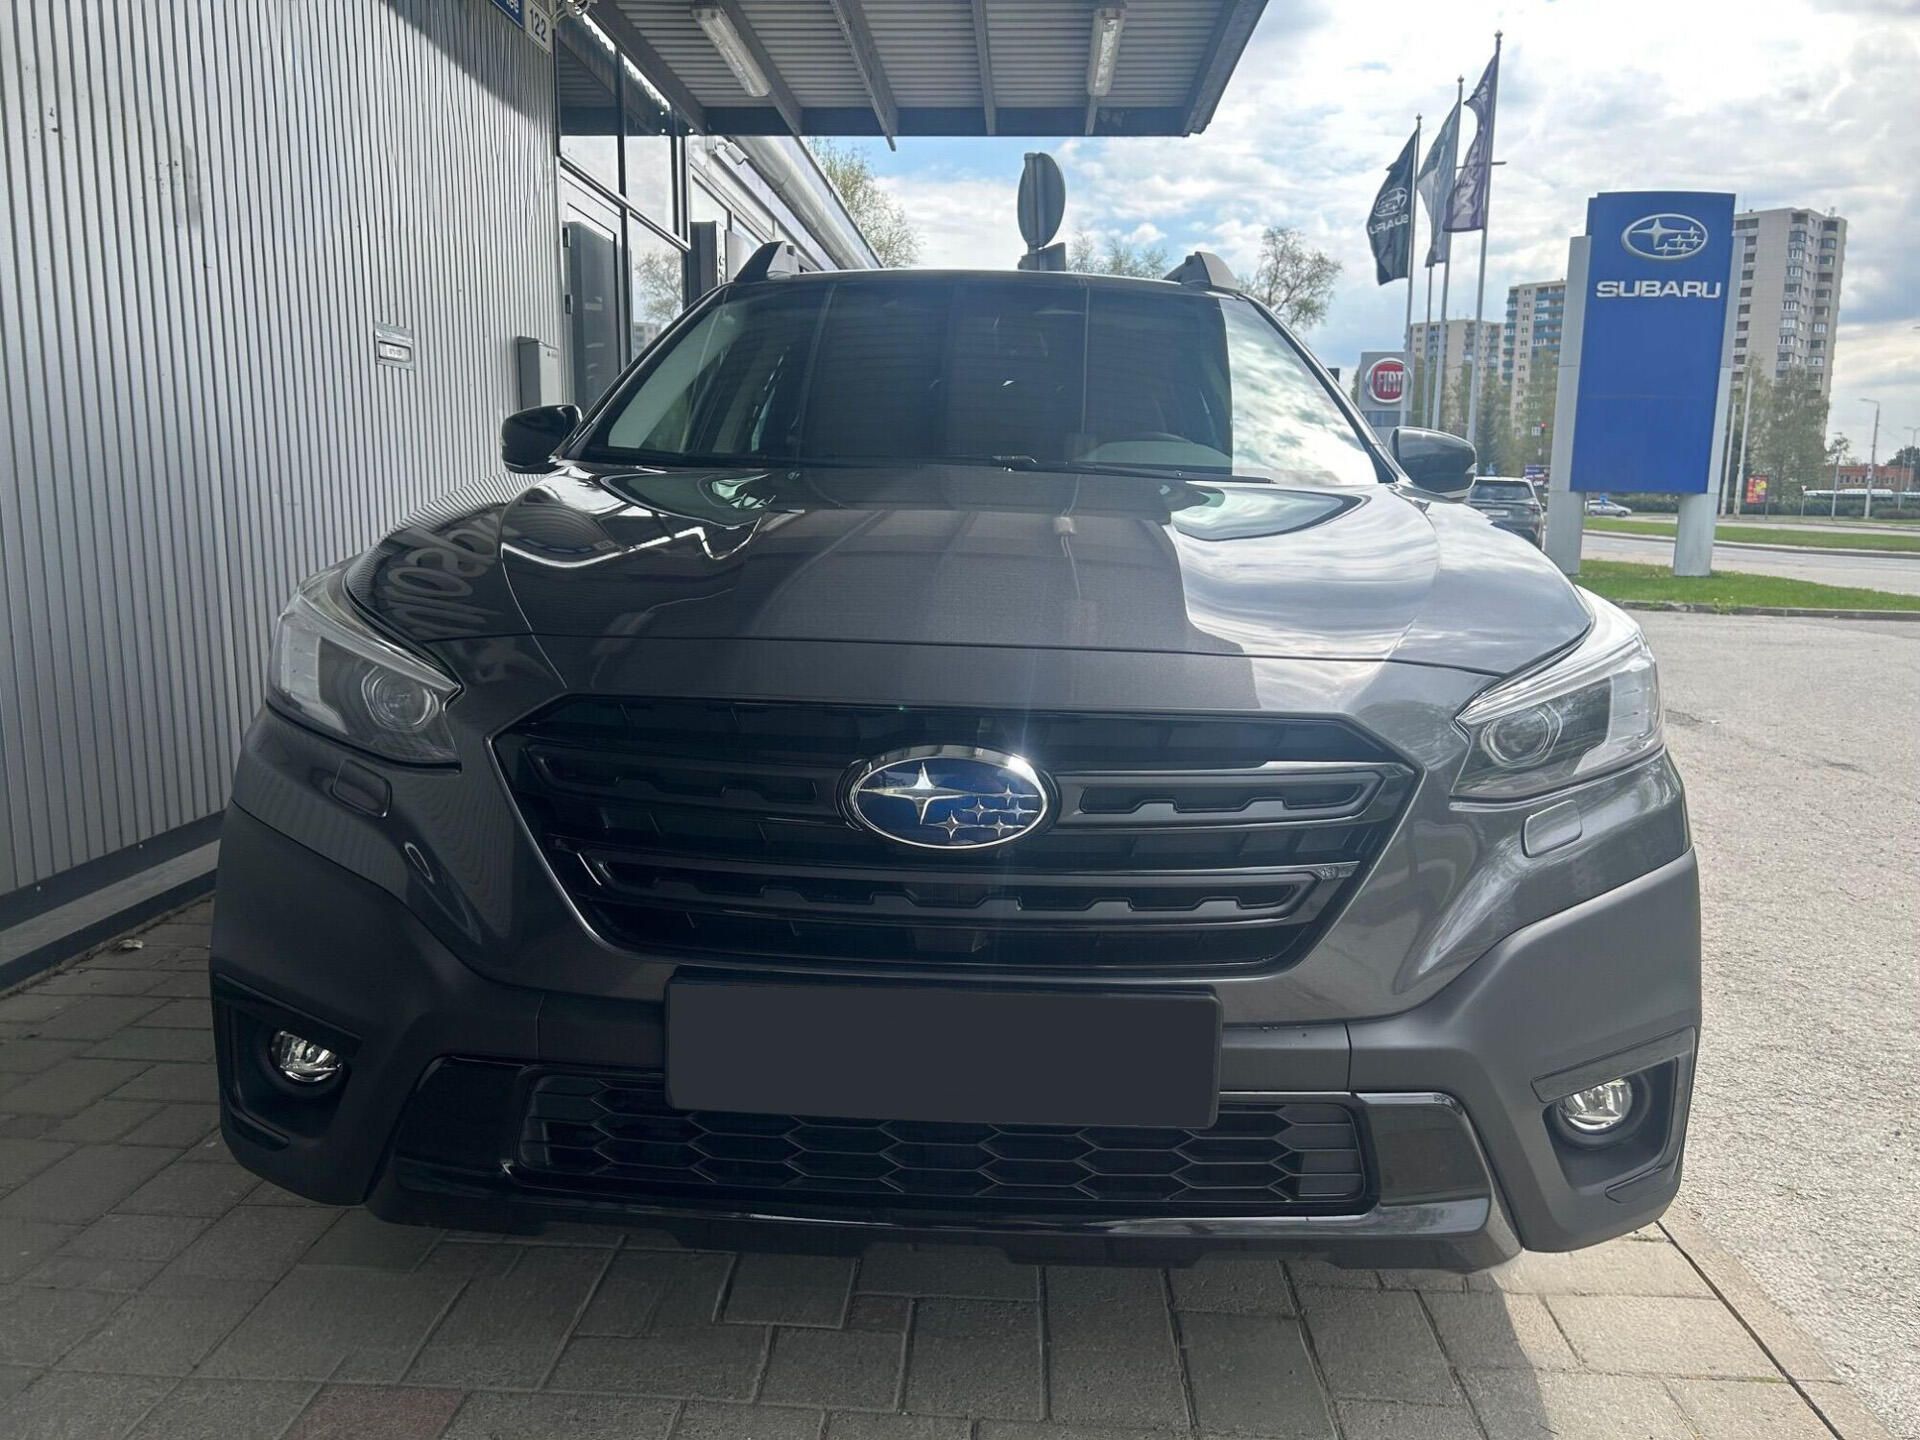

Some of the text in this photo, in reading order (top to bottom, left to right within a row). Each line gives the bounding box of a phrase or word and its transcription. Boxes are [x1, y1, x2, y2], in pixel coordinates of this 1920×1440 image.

[530, 9, 547, 43] 122
[1596, 280, 1722, 299] SUBARU
[1377, 370, 1404, 393] FIAT
